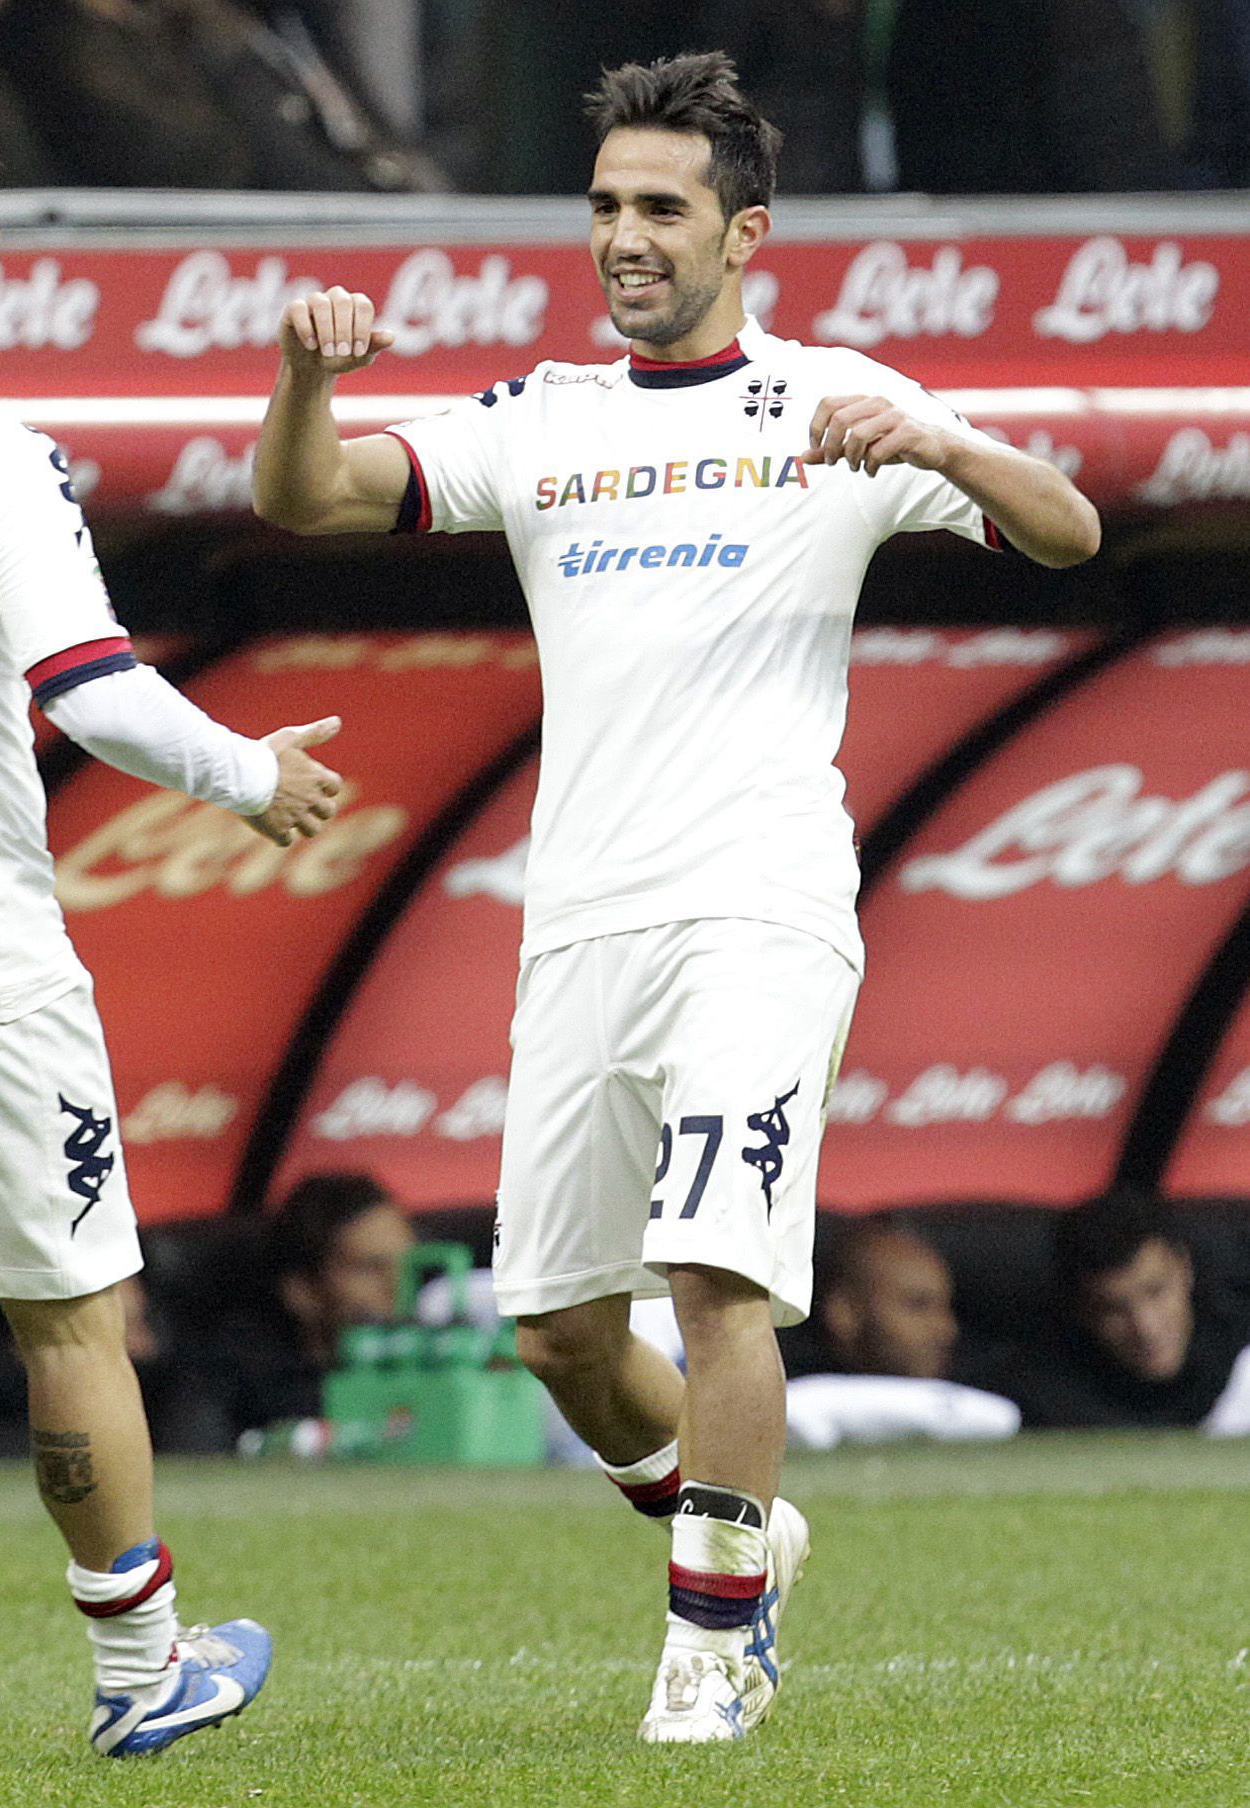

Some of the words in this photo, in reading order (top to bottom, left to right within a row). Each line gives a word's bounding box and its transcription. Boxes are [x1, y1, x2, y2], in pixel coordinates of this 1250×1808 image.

[372, 246, 549, 357] Lete
[813, 239, 1001, 346] Lete
[1033, 235, 1221, 343] Lete
[535, 455, 810, 511] SARDEGNA
[557, 533, 750, 578] tirrenia
